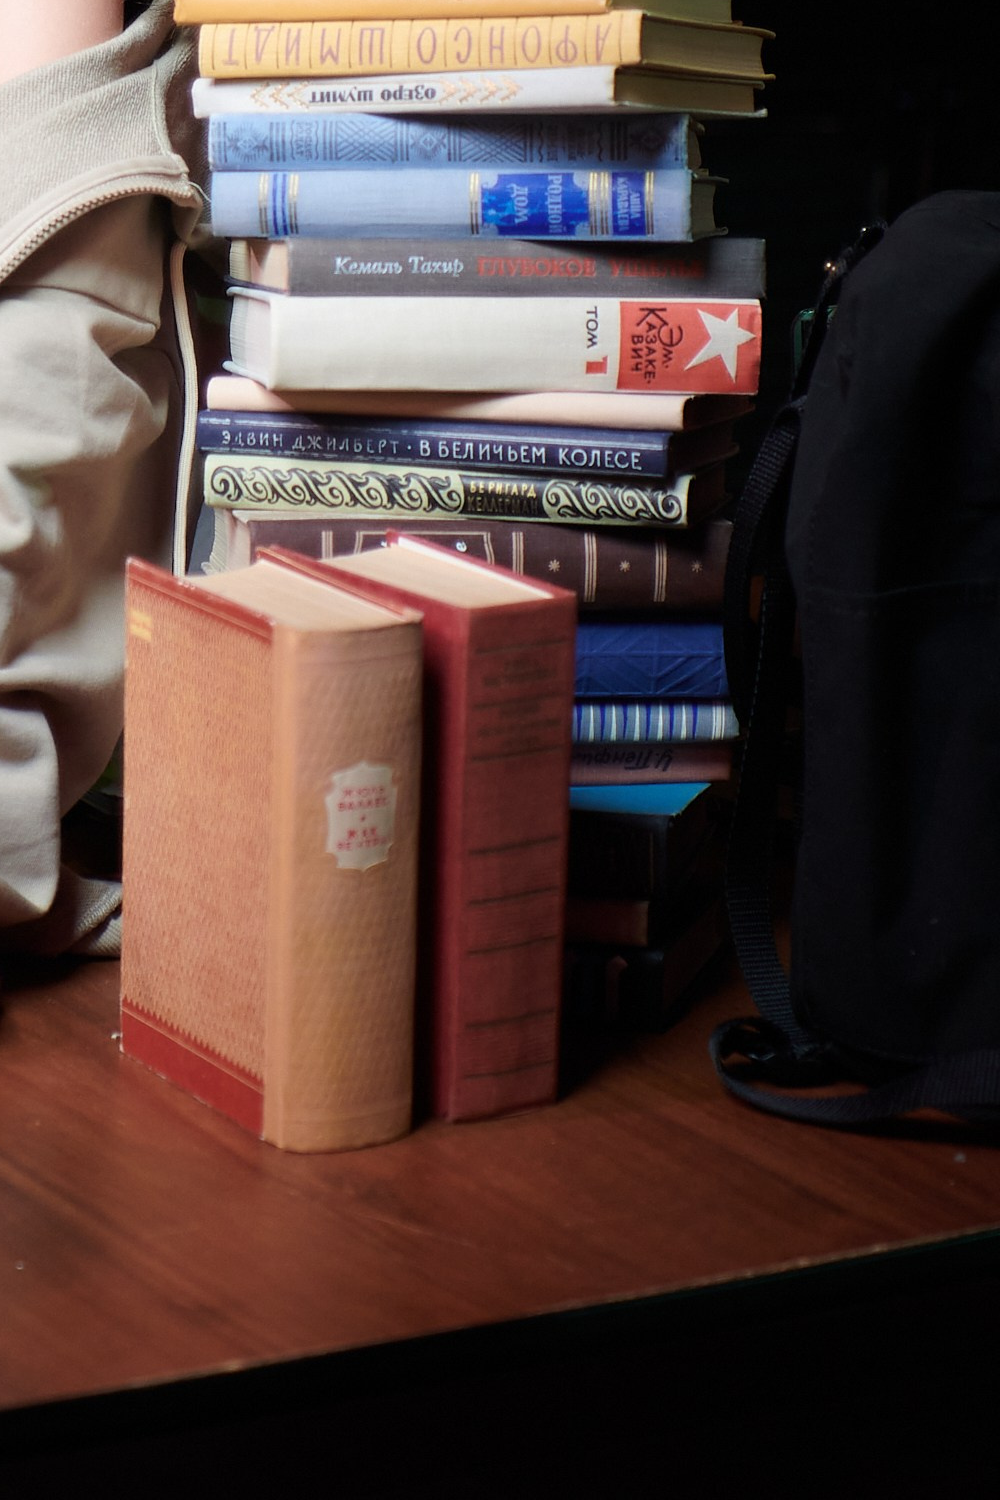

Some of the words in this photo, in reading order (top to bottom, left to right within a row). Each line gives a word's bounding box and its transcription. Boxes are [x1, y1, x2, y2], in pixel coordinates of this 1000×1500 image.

[221, 25, 386, 67] ШМИДТ
[415, 22, 613, 66] АФОНСО
[506, 182, 529, 225] ДОМ
[546, 174, 567, 235] РОДНОЙ
[333, 255, 403, 276] Кемаль
[408, 255, 464, 278] Тахир
[477, 256, 597, 278] ГЛУБОКОЕ
[586, 305, 599, 349] ТОМ
[585, 355, 608, 375] 1
[631, 334, 644, 372] ВИЧ
[221, 430, 284, 448] ЭДВИН
[291, 435, 400, 454] ДЖИЛБЕРТ
[419, 439, 431, 458] В
[438, 440, 547, 465] БЕЛИЧЬЕМ
[558, 448, 643, 471] КОЛЕСЕ
